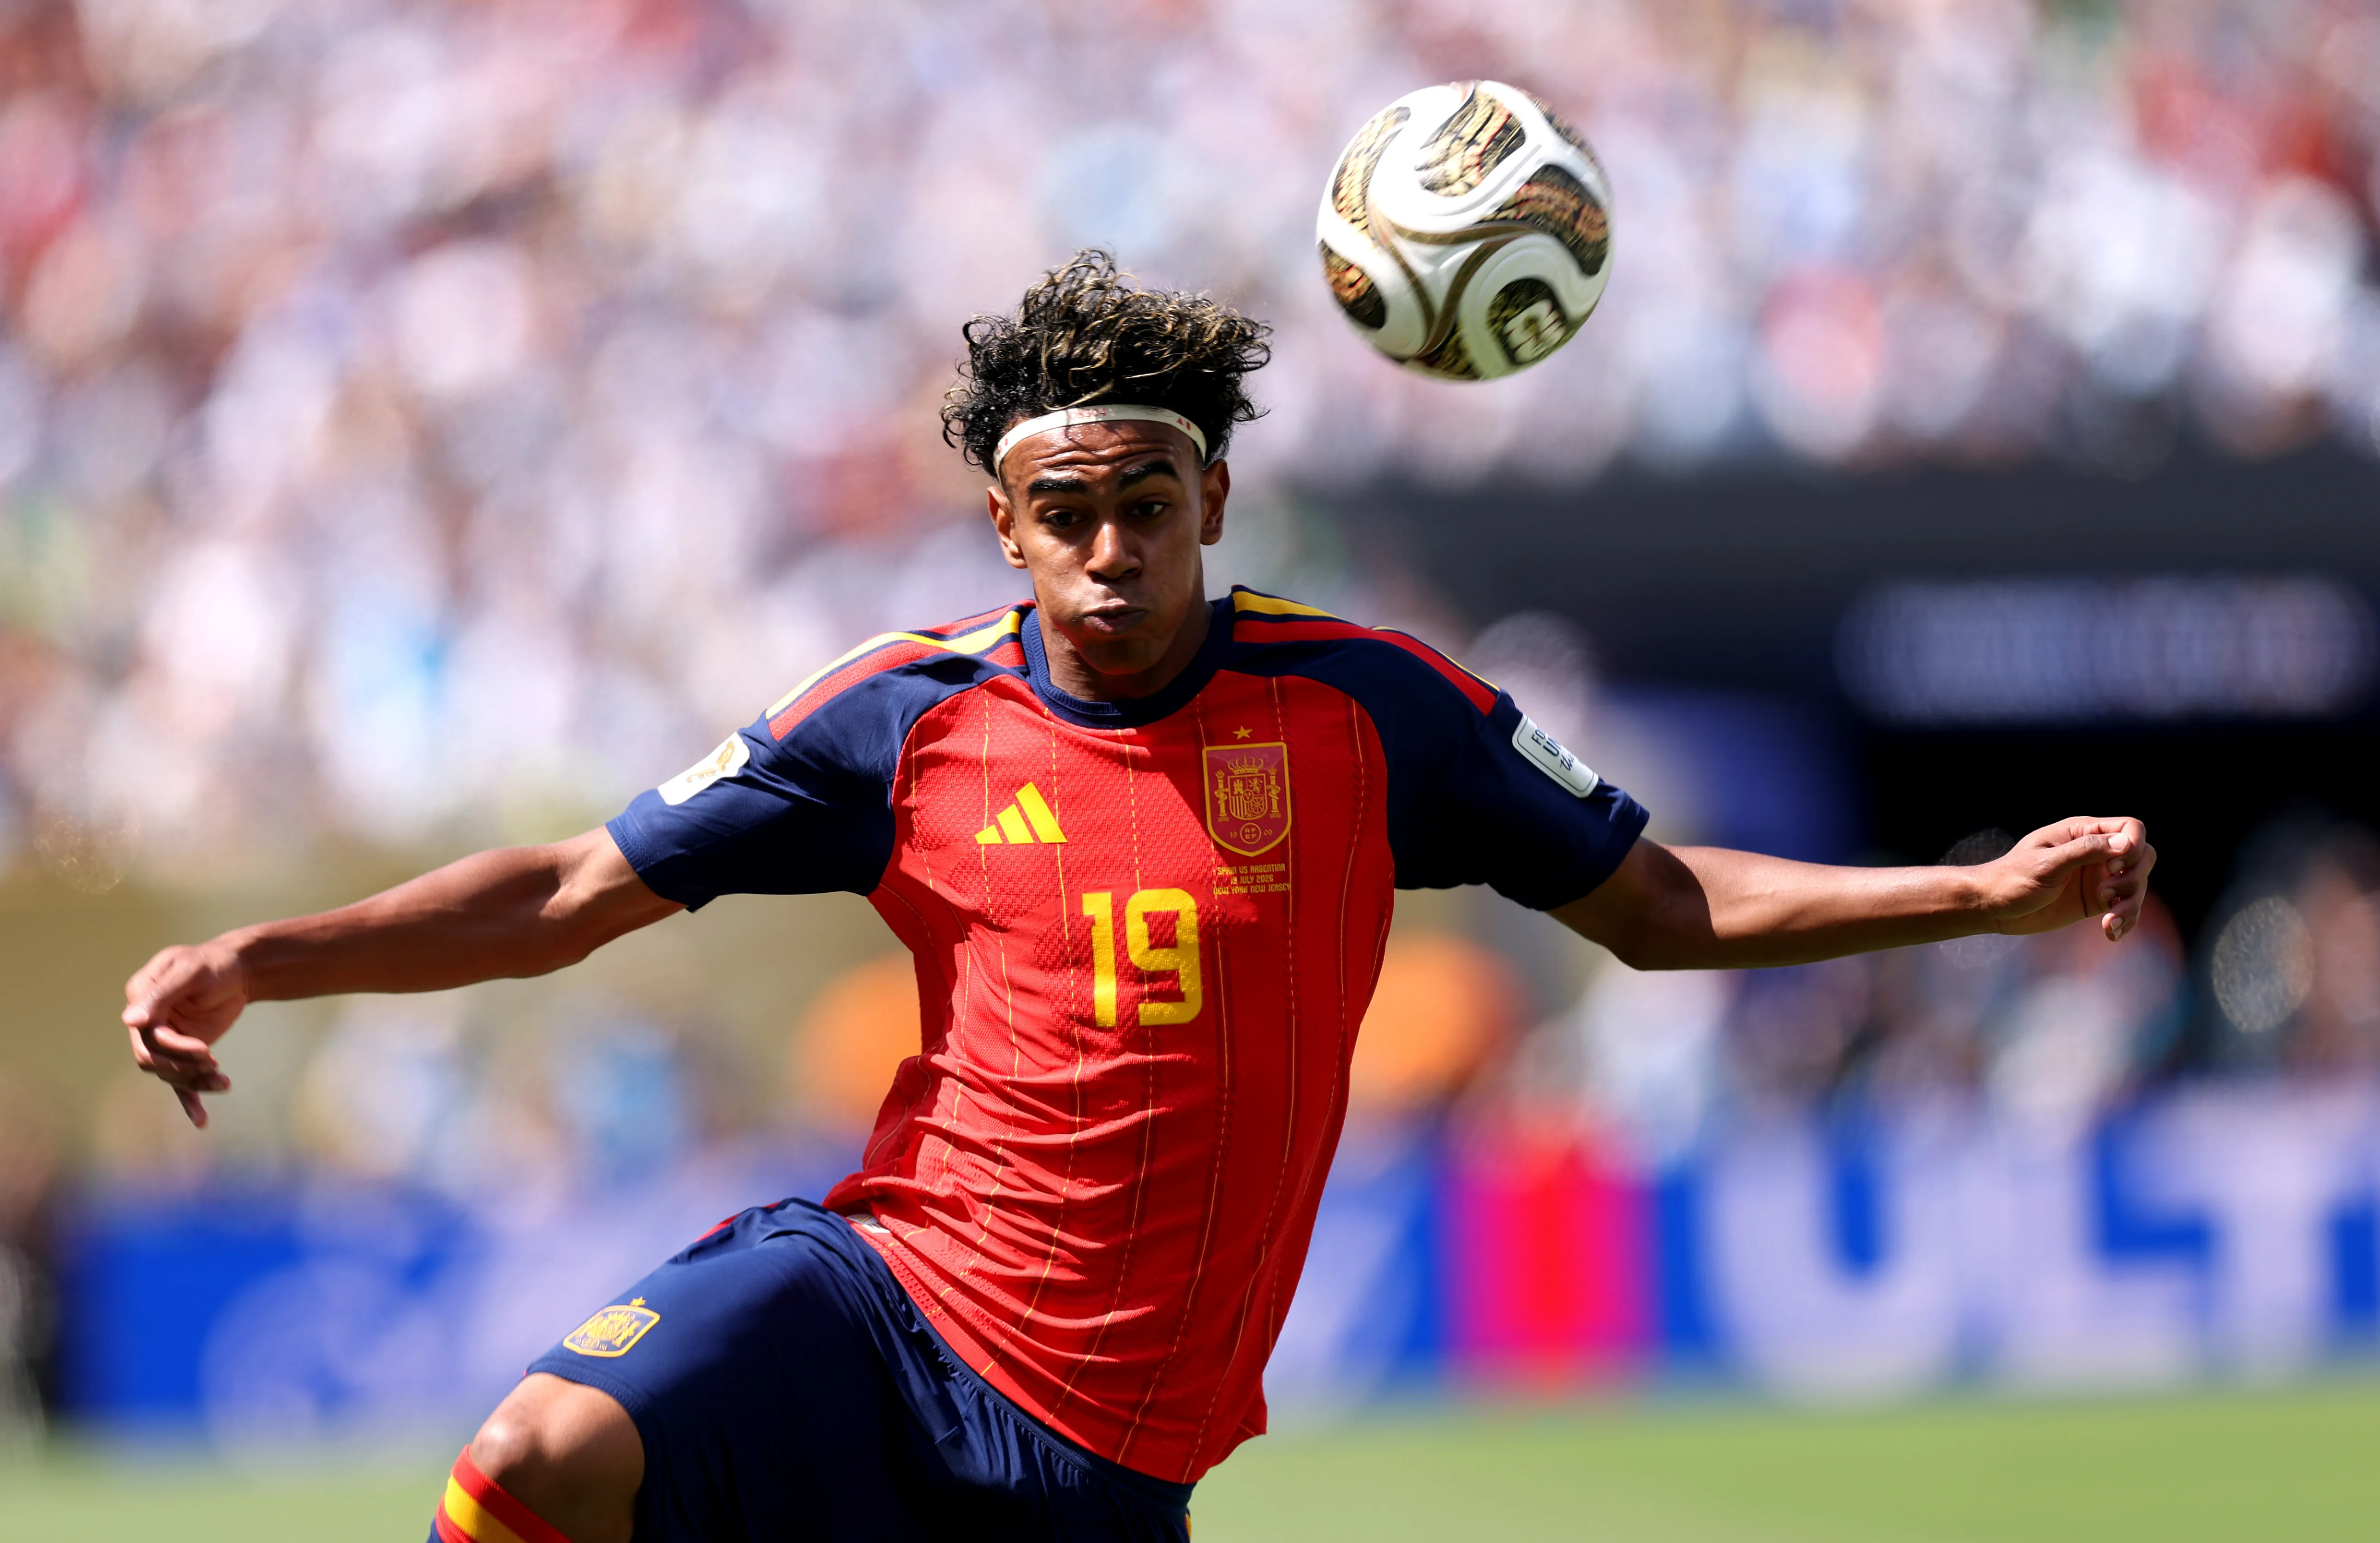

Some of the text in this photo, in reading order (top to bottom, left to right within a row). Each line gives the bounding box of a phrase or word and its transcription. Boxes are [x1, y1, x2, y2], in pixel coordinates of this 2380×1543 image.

[1217, 867, 1237, 875] SPAIN
[1250, 863, 1285, 873] ARGENTINA
[1240, 875, 1254, 884] JULY
[1256, 874, 1273, 883] 2026
[1213, 882, 1291, 895] NEW YORK NEW JERSEY
[1082, 888, 1203, 1028] 19
